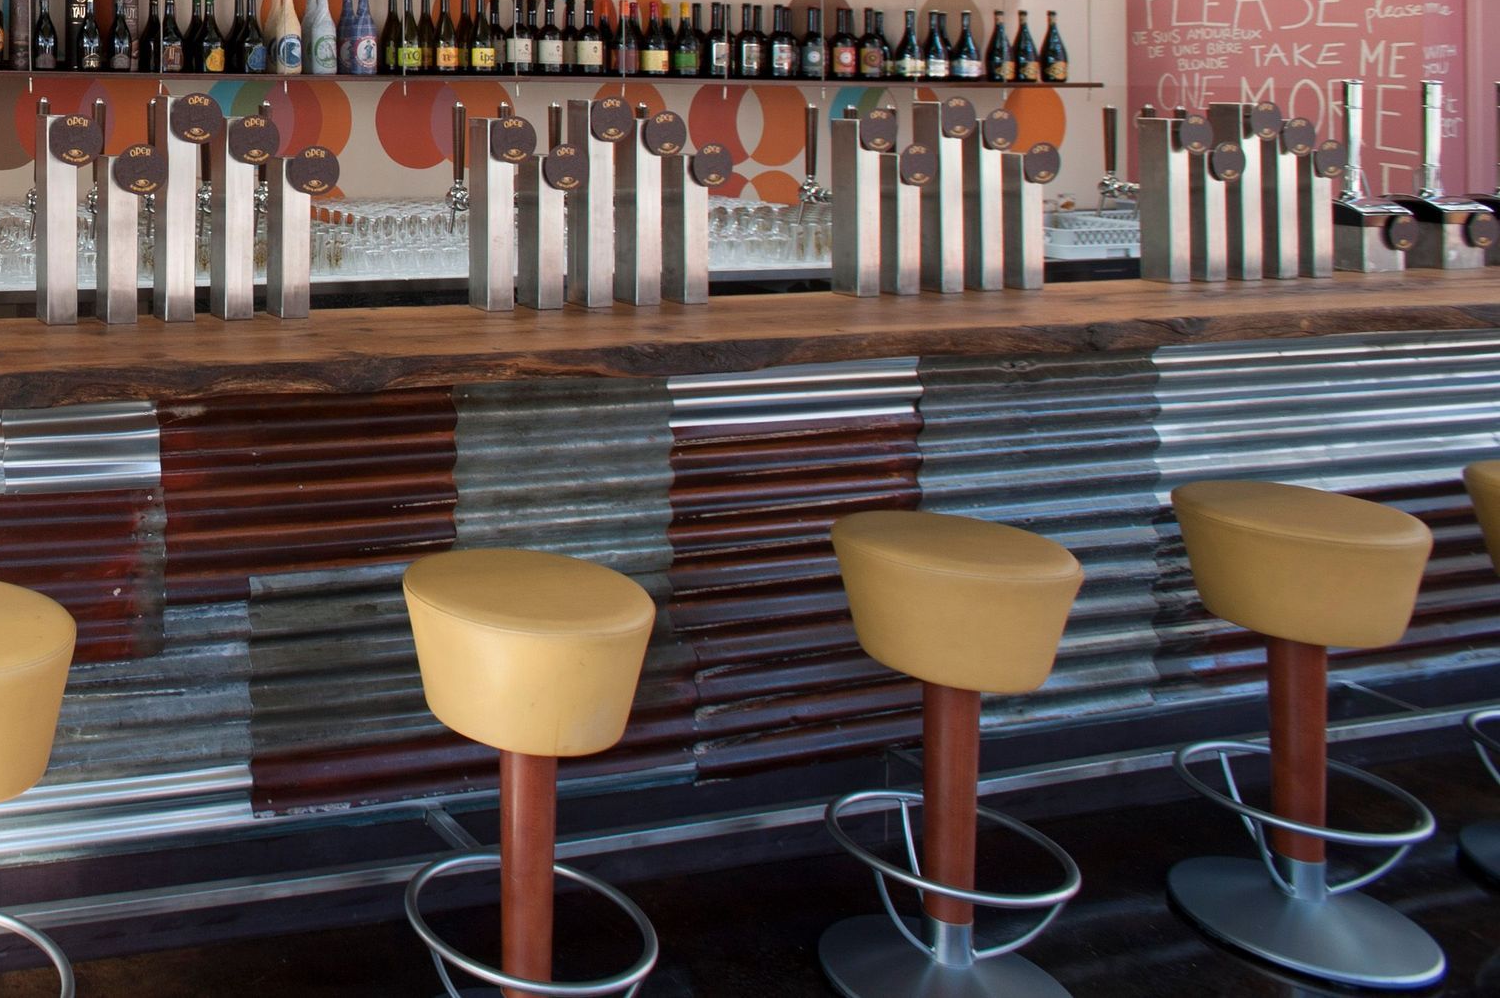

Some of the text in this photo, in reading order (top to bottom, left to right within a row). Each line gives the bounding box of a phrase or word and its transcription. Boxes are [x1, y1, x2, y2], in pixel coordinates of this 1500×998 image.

[1132, 28, 1262, 46] JE SUIS AMOUREUX
[1147, 45, 1165, 59] DE
[1172, 43, 1201, 57] UNE
[1250, 38, 1417, 78] TAKE ME
[1177, 57, 1229, 72] BLONDE
[1157, 72, 1225, 111] ONE
